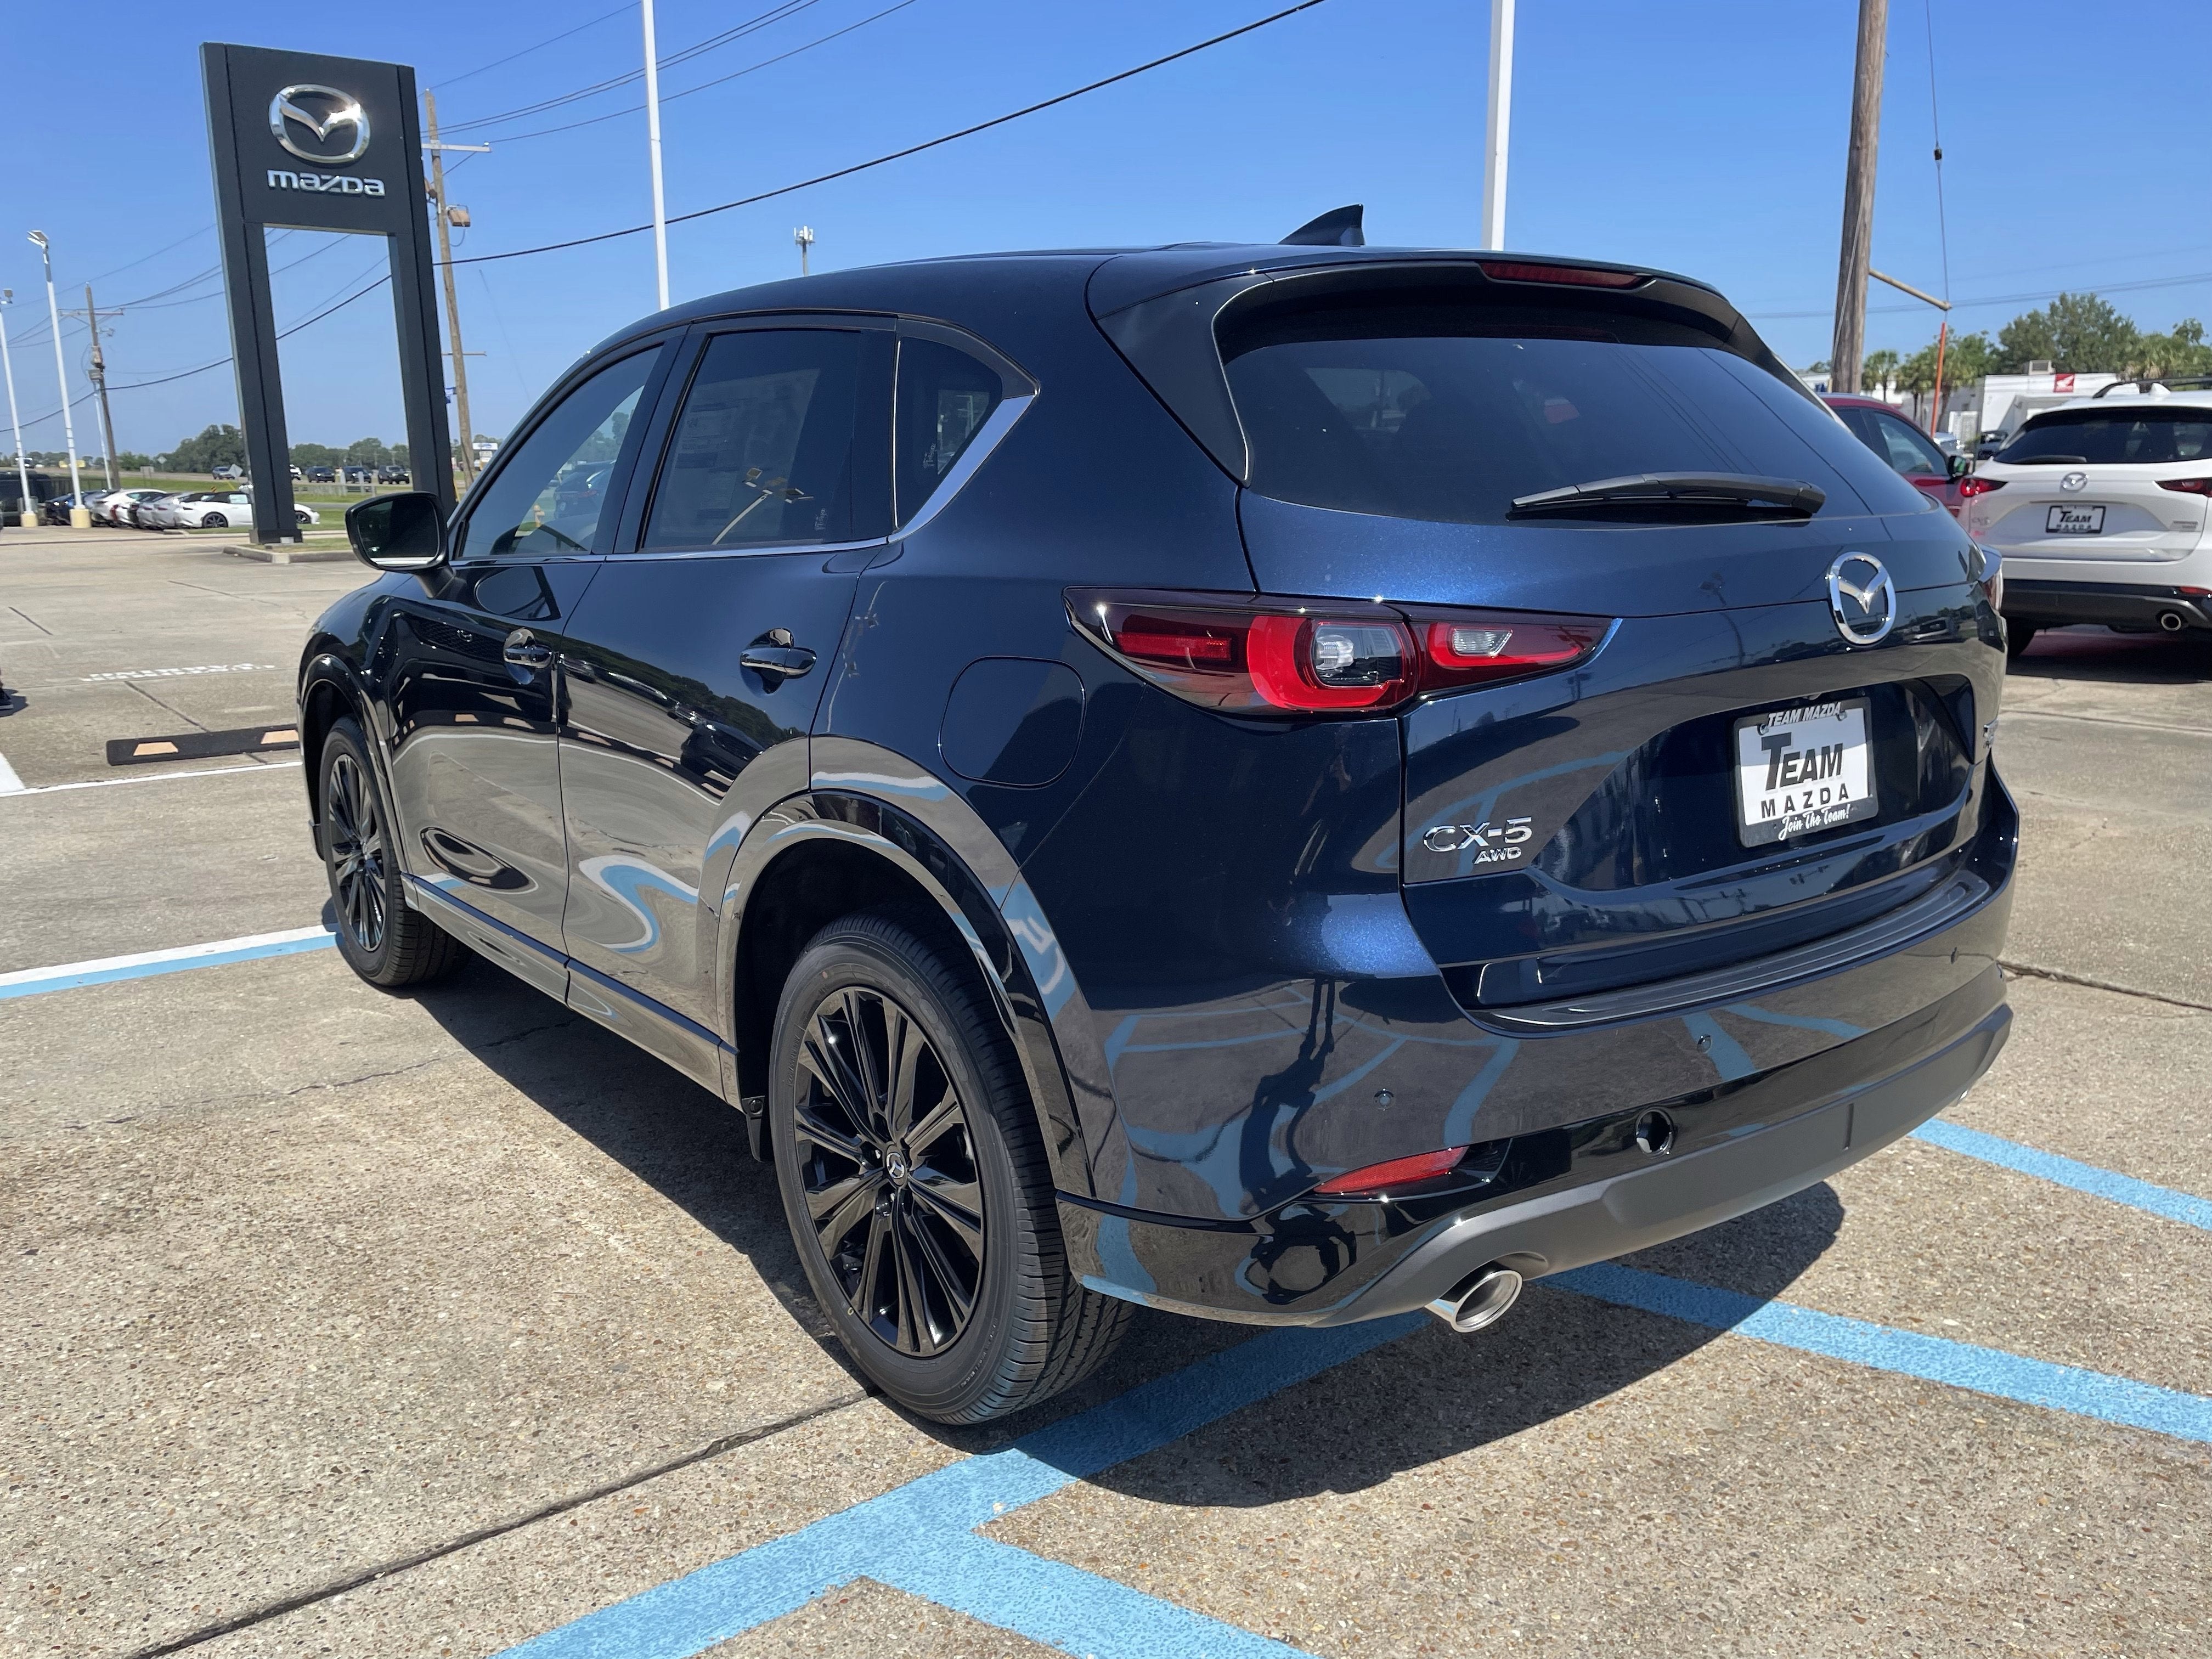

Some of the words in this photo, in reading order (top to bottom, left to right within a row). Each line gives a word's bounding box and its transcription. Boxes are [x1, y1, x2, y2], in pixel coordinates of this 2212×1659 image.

[1768, 708, 1802, 726] TEAM
[1803, 702, 1842, 720] MAZDA
[1761, 732, 1843, 791] TEAM
[1760, 783, 1849, 819] MAZDA
[1423, 816, 1533, 852] CX-5
[1778, 815, 1804, 841] Join
[1803, 810, 1821, 829] The
[1821, 804, 1852, 823] Team!
[1473, 846, 1522, 865] AWD
